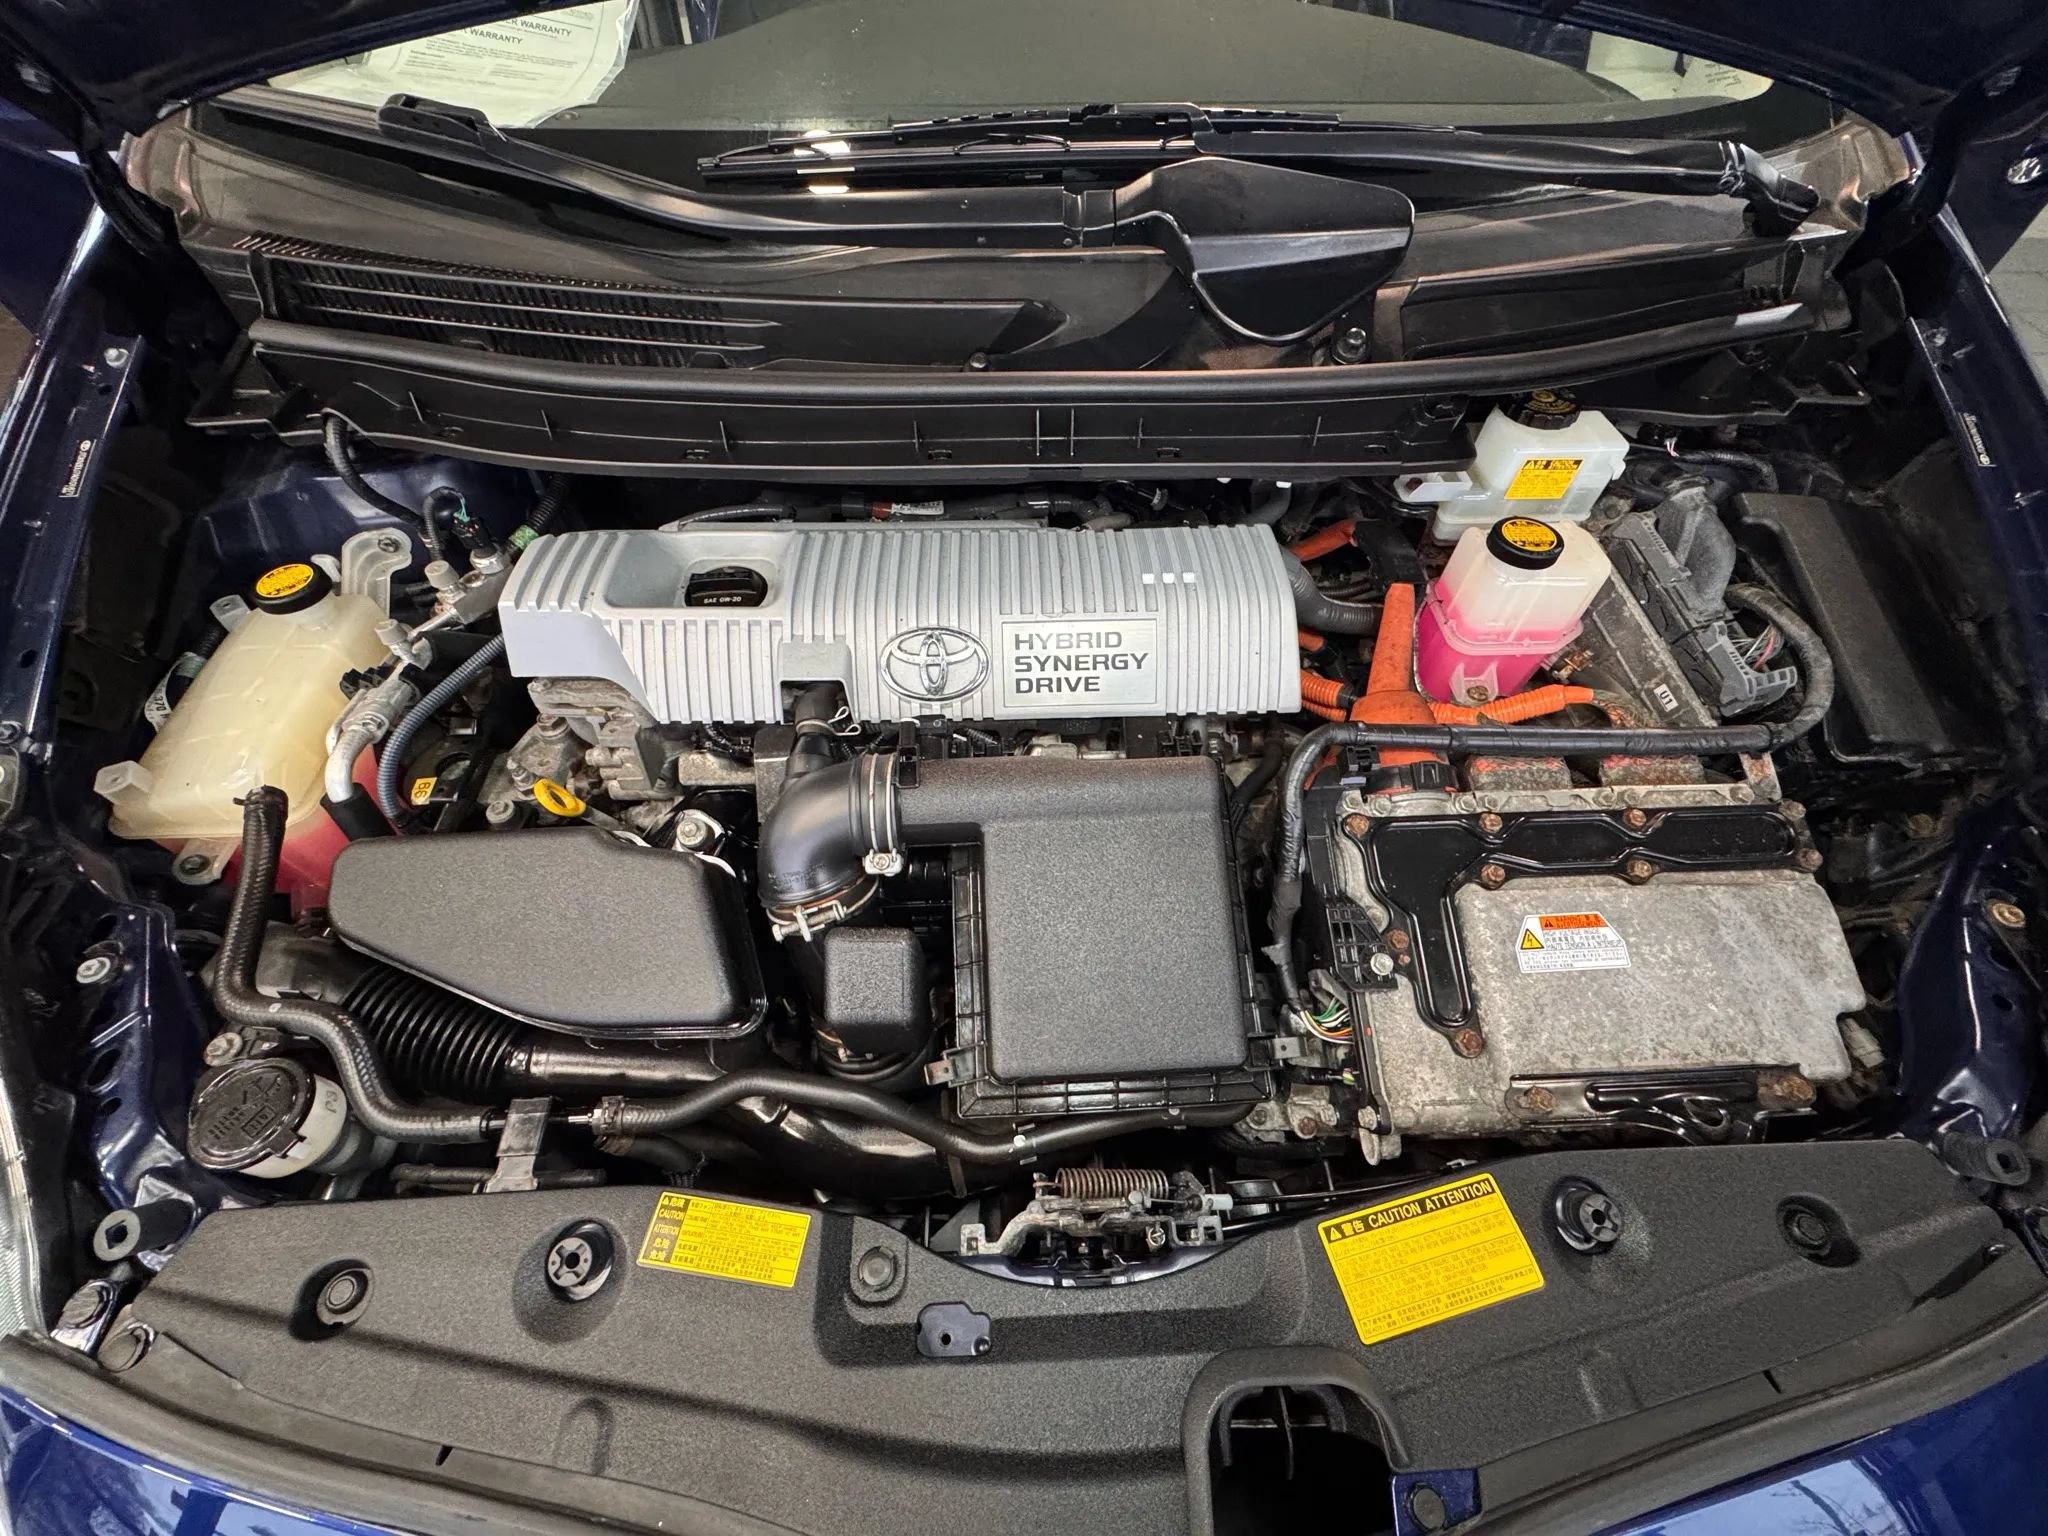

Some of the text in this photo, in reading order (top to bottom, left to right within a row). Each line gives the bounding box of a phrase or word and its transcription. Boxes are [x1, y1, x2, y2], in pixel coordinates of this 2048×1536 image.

[470, 27, 523, 44] WARRANTY
[520, 19, 573, 37] WARRANTY
[1014, 631, 1122, 650] HYBRID
[1014, 653, 1149, 672] SYNERGY
[1015, 676, 1100, 693] DRIVE
[1660, 690, 1673, 705] U1
[1368, 1201, 1422, 1228] CAUTION
[1425, 1180, 1493, 1212] ATTENTION
[658, 1208, 686, 1220] CAUTION
